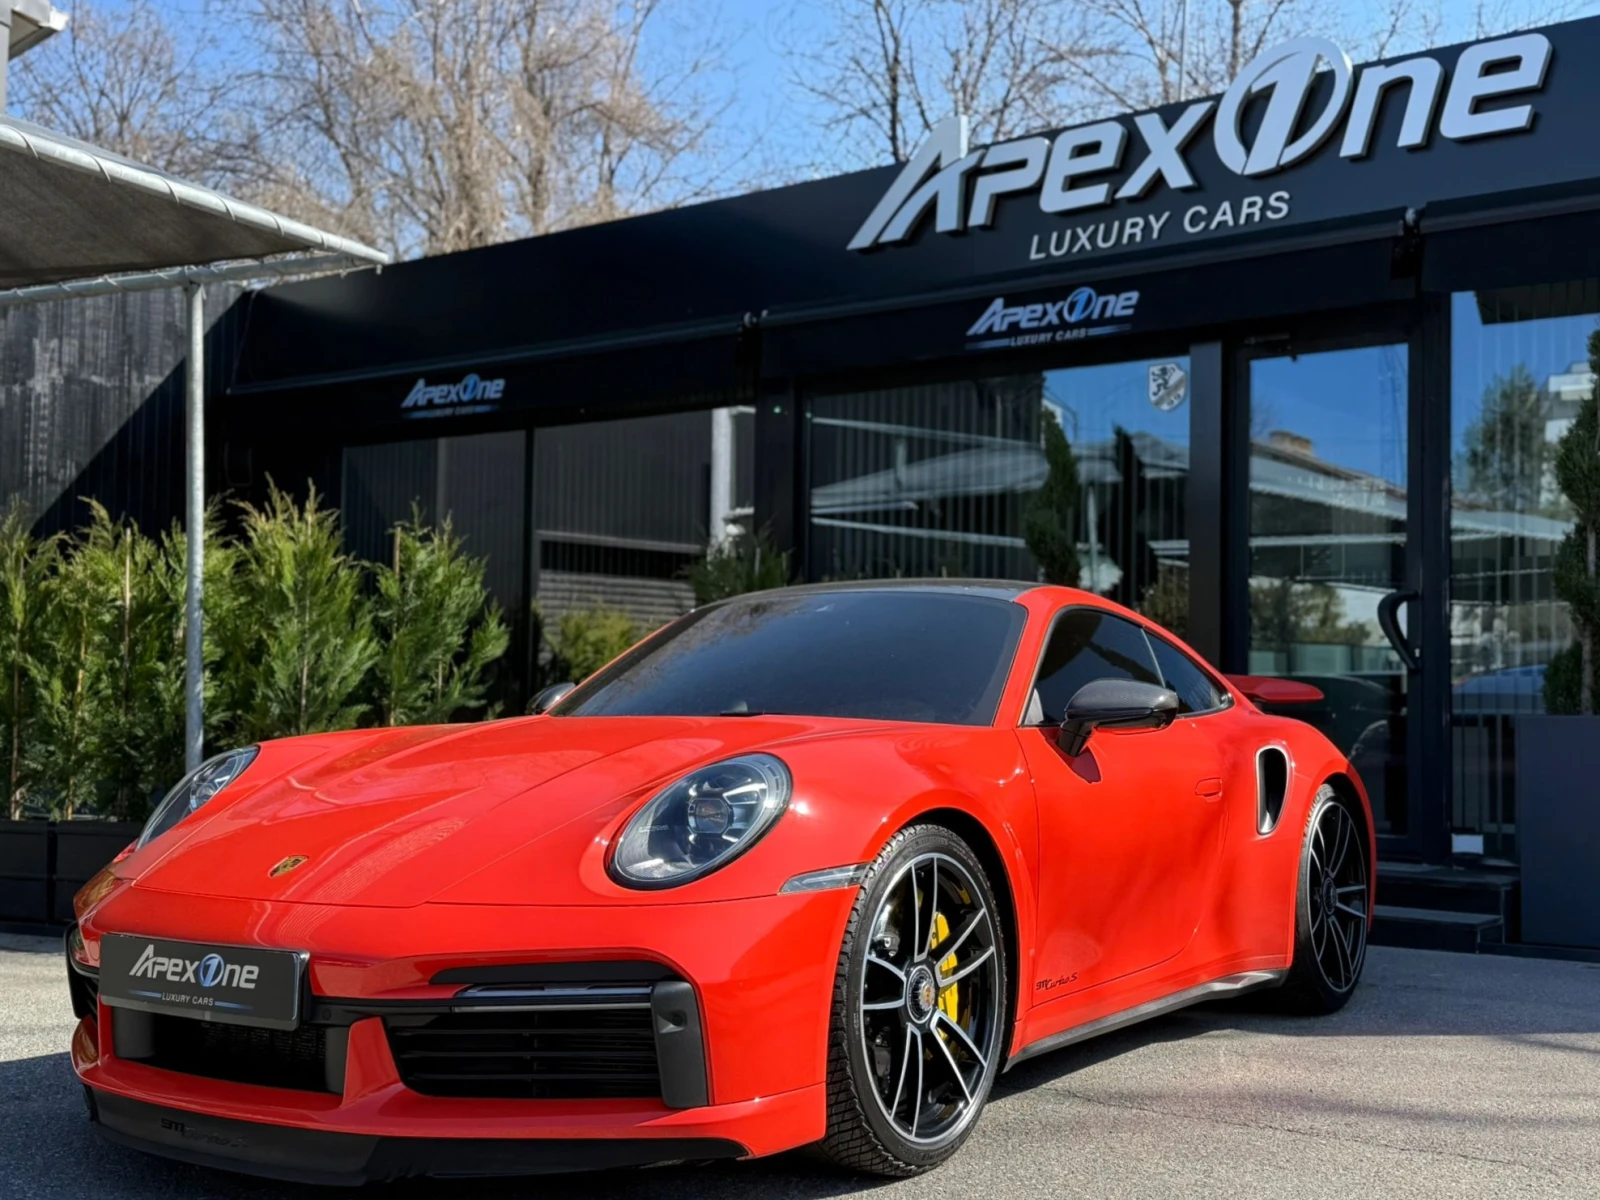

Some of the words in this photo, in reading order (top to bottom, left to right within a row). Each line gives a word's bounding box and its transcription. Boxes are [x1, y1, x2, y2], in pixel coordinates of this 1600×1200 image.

[1029, 210, 1172, 260] LUXURY
[1184, 191, 1291, 235] CARS
[1010, 333, 1053, 347] LUXURY
[1055, 327, 1087, 341] CARS
[162, 992, 191, 1003] LUXURY
[192, 995, 214, 1006] CARS
